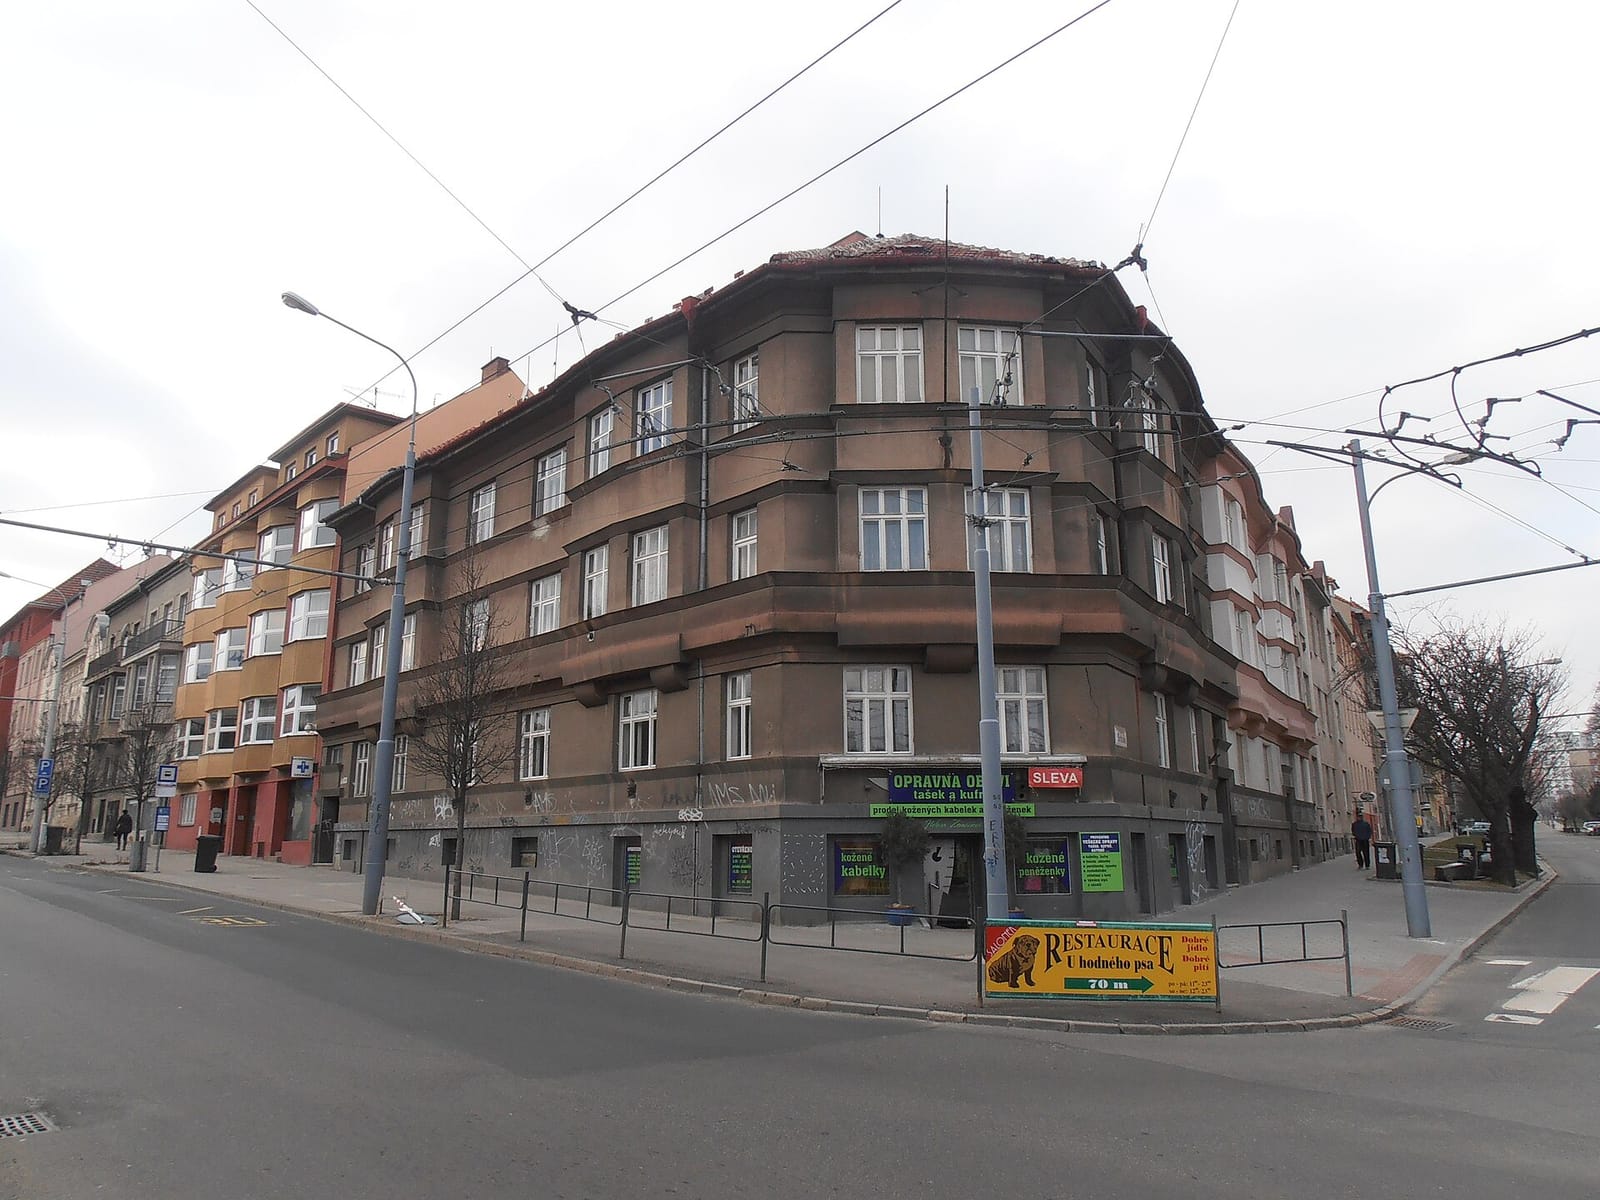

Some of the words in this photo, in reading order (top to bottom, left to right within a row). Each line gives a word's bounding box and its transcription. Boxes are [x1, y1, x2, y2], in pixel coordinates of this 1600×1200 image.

[41, 760, 50, 771] P
[38, 778, 48, 789] P
[894, 774, 961, 788] OPRAVNA
[1032, 772, 1078, 784] SLEVA
[913, 789, 945, 800] tašek
[949, 792, 956, 800] a
[902, 805, 942, 815] kožených
[944, 806, 977, 815] kabelek
[841, 851, 873, 862] kožené
[1026, 850, 1065, 864] kožené
[841, 864, 886, 879] kabelky
[1018, 866, 1065, 879] peněženky
[1181, 935, 1209, 944] Dobré
[1187, 943, 1208, 952] jídlo
[1044, 933, 1175, 975] RESTAURACE
[1182, 954, 1210, 962] Dobré
[1067, 955, 1076, 969] U
[1079, 955, 1131, 969] hodného
[1134, 959, 1154, 973] psa
[1193, 963, 1209, 972] pití
[1088, 979, 1109, 990] 70
[1113, 982, 1129, 990] m
